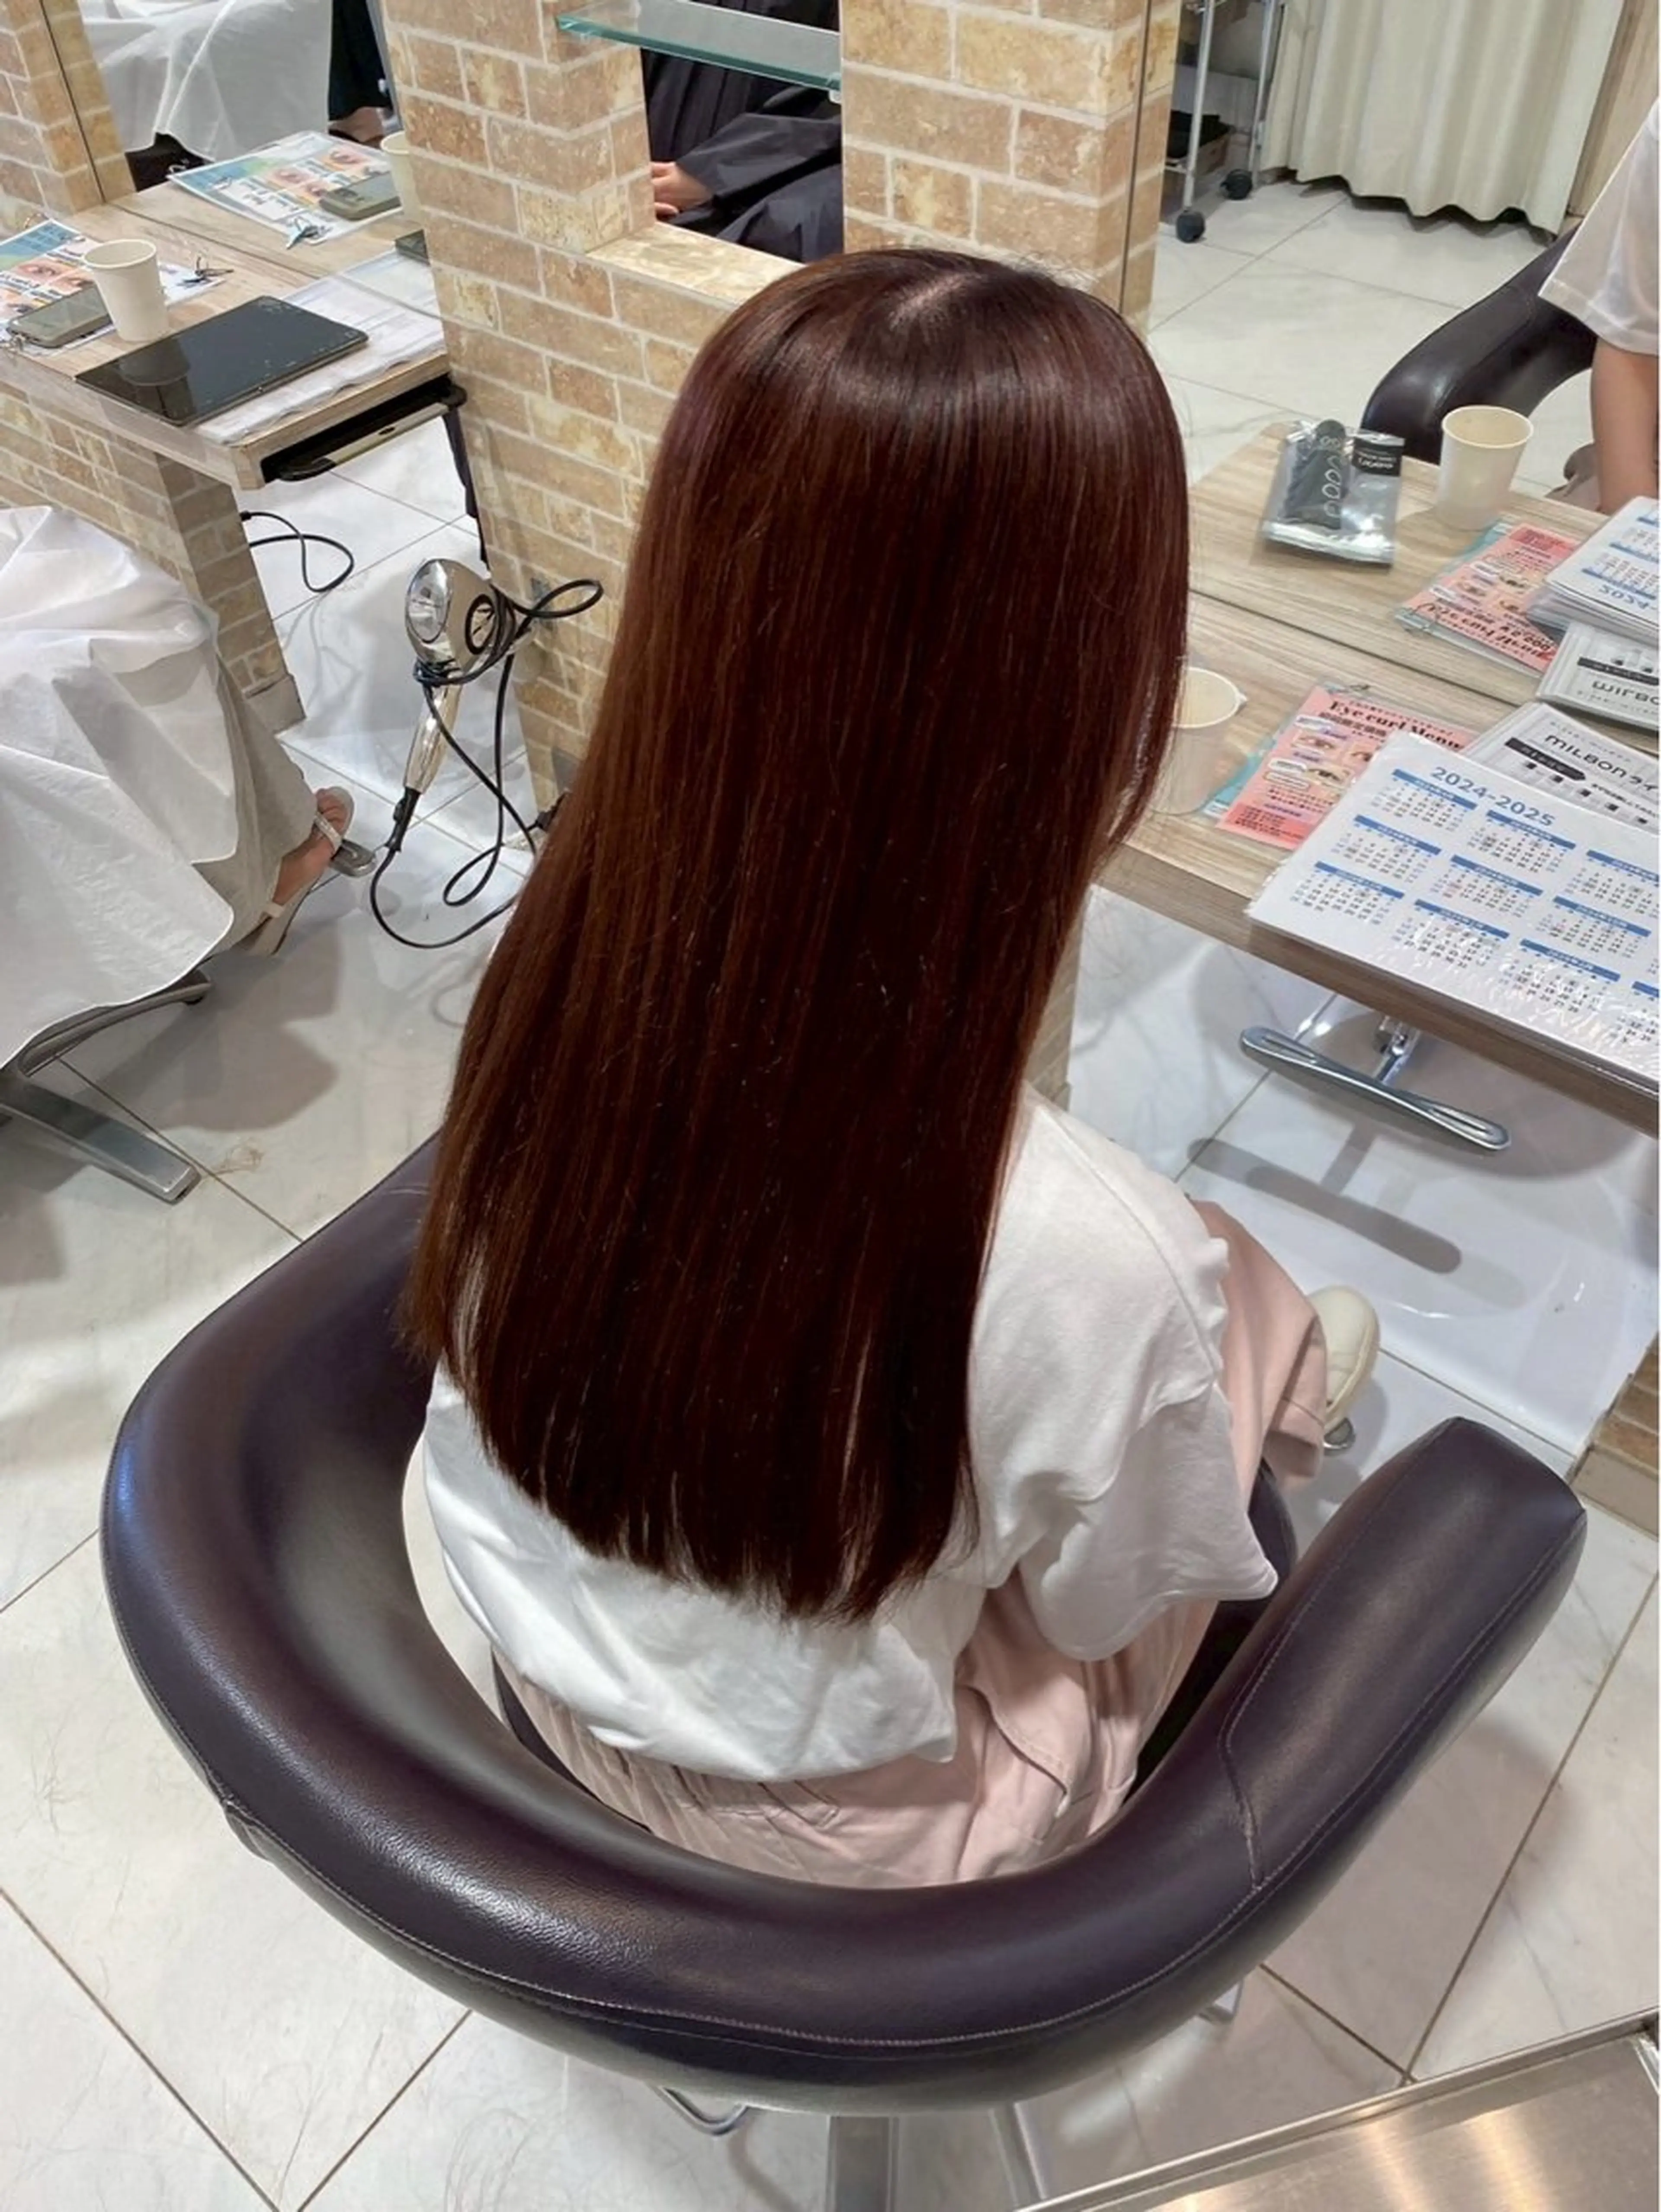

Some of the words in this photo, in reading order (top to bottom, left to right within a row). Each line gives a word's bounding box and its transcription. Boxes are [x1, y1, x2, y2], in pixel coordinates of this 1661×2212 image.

[1366, 714, 1406, 730] curl
[1544, 734, 1628, 778] MILBON
[1430, 766, 1556, 827] 2024-2025
